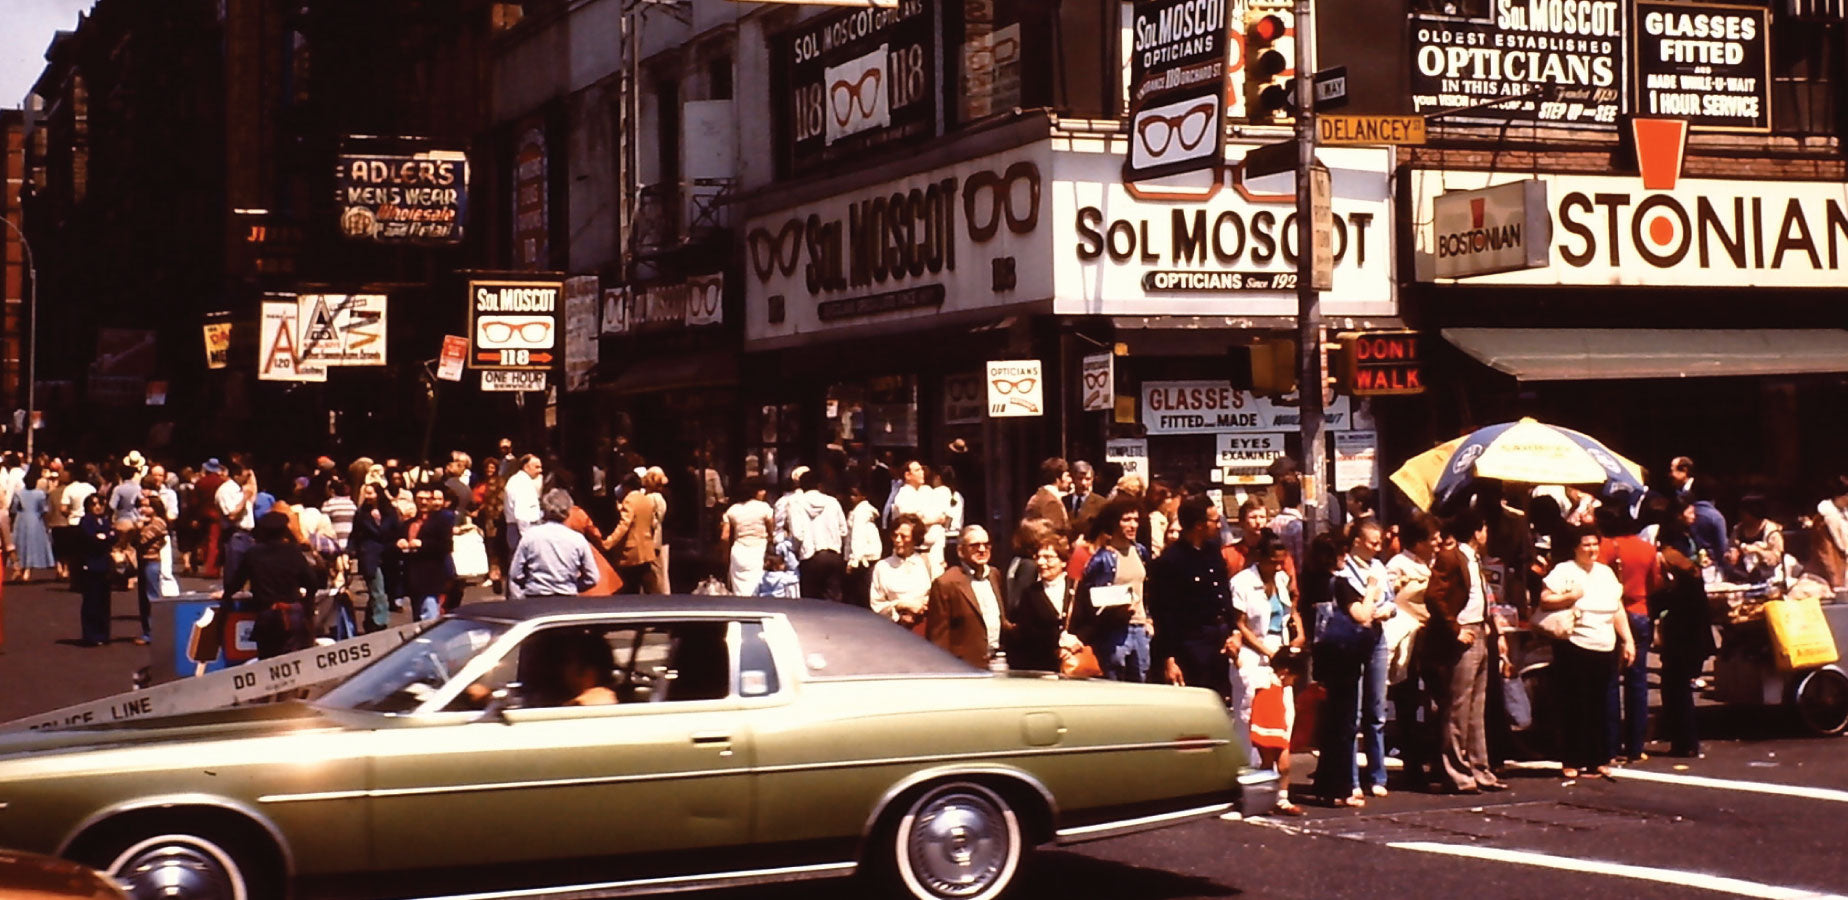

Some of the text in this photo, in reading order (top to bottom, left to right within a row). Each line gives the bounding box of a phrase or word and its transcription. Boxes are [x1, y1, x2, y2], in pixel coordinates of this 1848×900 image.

[1159, 0, 1225, 44] MOSCOT
[1529, 0, 1617, 36] MOSCOT
[1645, 12, 1756, 40] GLASSES
[795, 32, 820, 63] SOL
[823, 7, 875, 52] MOSCOT
[1418, 29, 1613, 54] OLDEST ESTABLISHED
[1144, 35, 1213, 67] OPTICIANS
[1660, 39, 1744, 64] FITTED
[890, 43, 925, 109] 118
[1417, 44, 1614, 87] OPTICIANS
[1441, 80, 1543, 98] IN THIS ARE
[1647, 74, 1677, 89] MADE
[795, 82, 823, 142] 118
[1538, 101, 1567, 119] STEP
[1595, 104, 1618, 122] SEE
[1649, 90, 1759, 117] 1 HOUR SERVICE
[1322, 119, 1411, 141] DELANCEY
[352, 160, 455, 185] ADLER'S
[406, 187, 458, 205] WEAR
[849, 177, 957, 287] MOSCOT
[1075, 206, 1160, 263] SOL
[1439, 222, 1521, 259] BOSTONIAN
[1547, 192, 1848, 269] STONIA
[1154, 273, 1242, 290] OPTICIANS
[1271, 273, 1297, 290] 192
[500, 289, 556, 312] MOSCOT
[500, 349, 530, 365] 118
[1357, 338, 1416, 359] DONT
[486, 371, 543, 383] ONE HOUR
[991, 367, 1038, 376] OPTICIANS
[1357, 368, 1419, 389] WALK
[1150, 387, 1244, 411] GLASSES
[1161, 415, 1204, 429] FITTED
[1217, 413, 1257, 427] MADE
[1108, 446, 1143, 457] COMPLETE
[1222, 450, 1281, 460] EXAMINED
[1231, 438, 1271, 449] EYES
[112, 697, 152, 719] LINE
[234, 672, 256, 690] DO
[270, 660, 301, 681] NOT
[316, 643, 371, 670] CROSS
